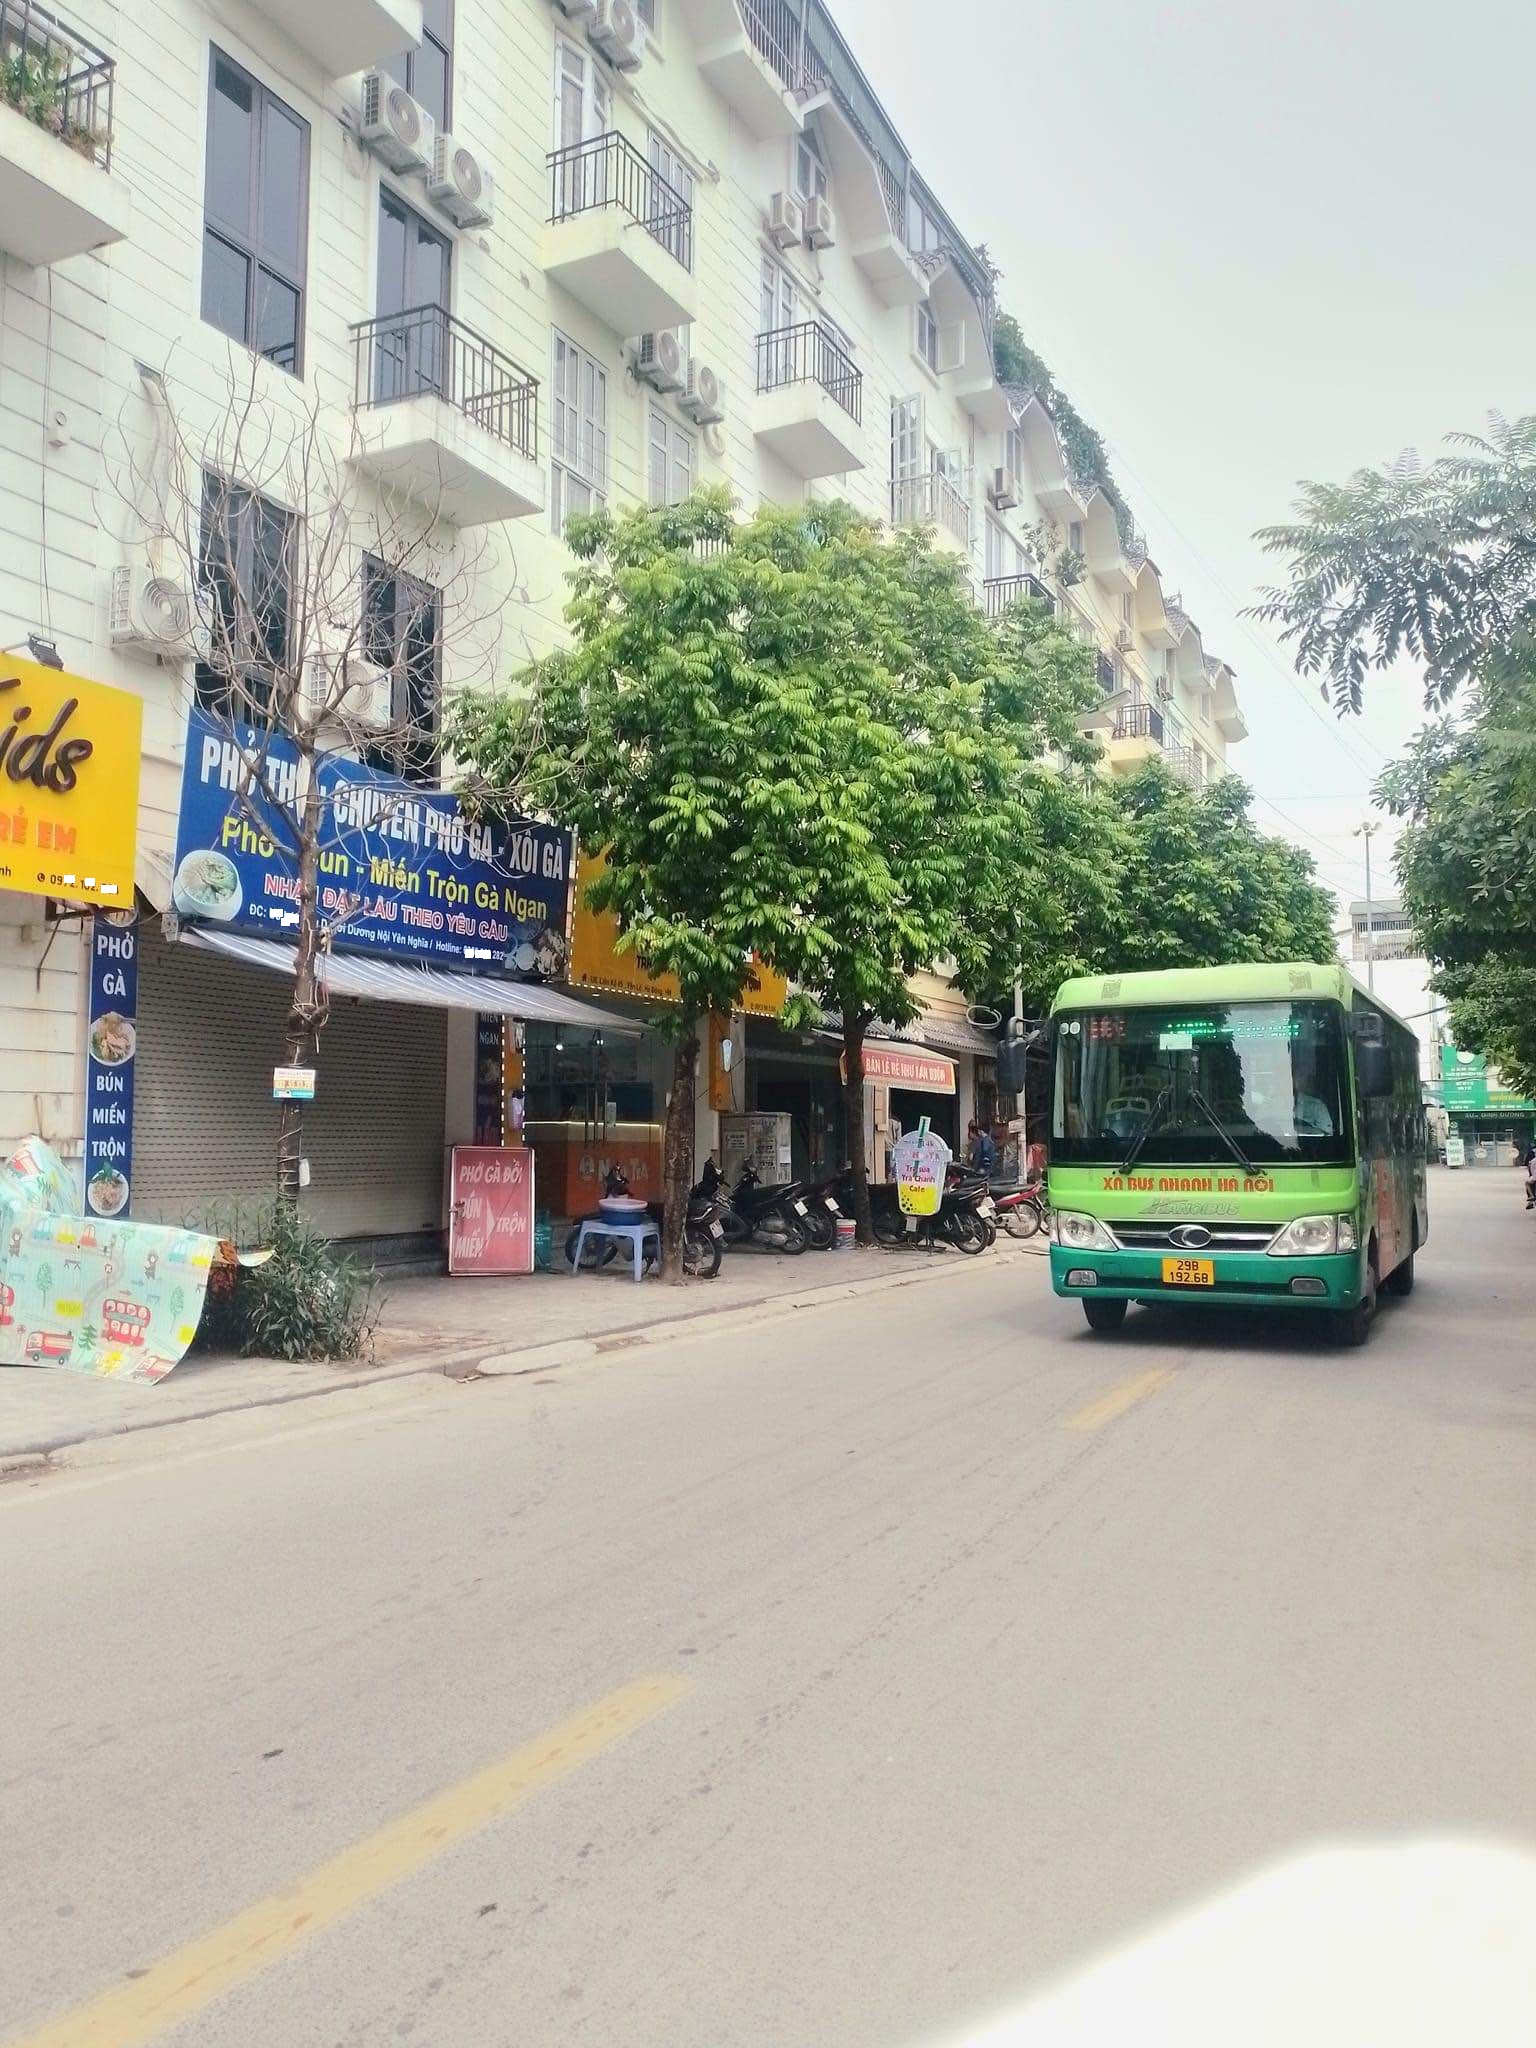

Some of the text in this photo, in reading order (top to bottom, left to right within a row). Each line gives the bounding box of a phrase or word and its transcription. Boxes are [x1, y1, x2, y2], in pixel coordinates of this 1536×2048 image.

[38, 820, 76, 854] EM
[509, 829, 539, 875] XÔI
[542, 838, 564, 880] GÀ
[427, 869, 469, 908] Trộn
[475, 881, 499, 911] Gà
[505, 888, 547, 922] Ngan
[249, 903, 267, 917] ĐC:
[401, 904, 444, 930] THEO
[446, 912, 476, 936] YÊU
[98, 931, 134, 960] PHỞ
[102, 968, 126, 997] GÀ
[96, 1071, 123, 1092] BÚN
[92, 1101, 126, 1125] MIẾN
[91, 1136, 126, 1160] TRỘN
[1127, 1176, 1154, 1192] BUS
[1169, 1271, 1209, 1284] 192.68
[1177, 1260, 1199, 1271] 29B
